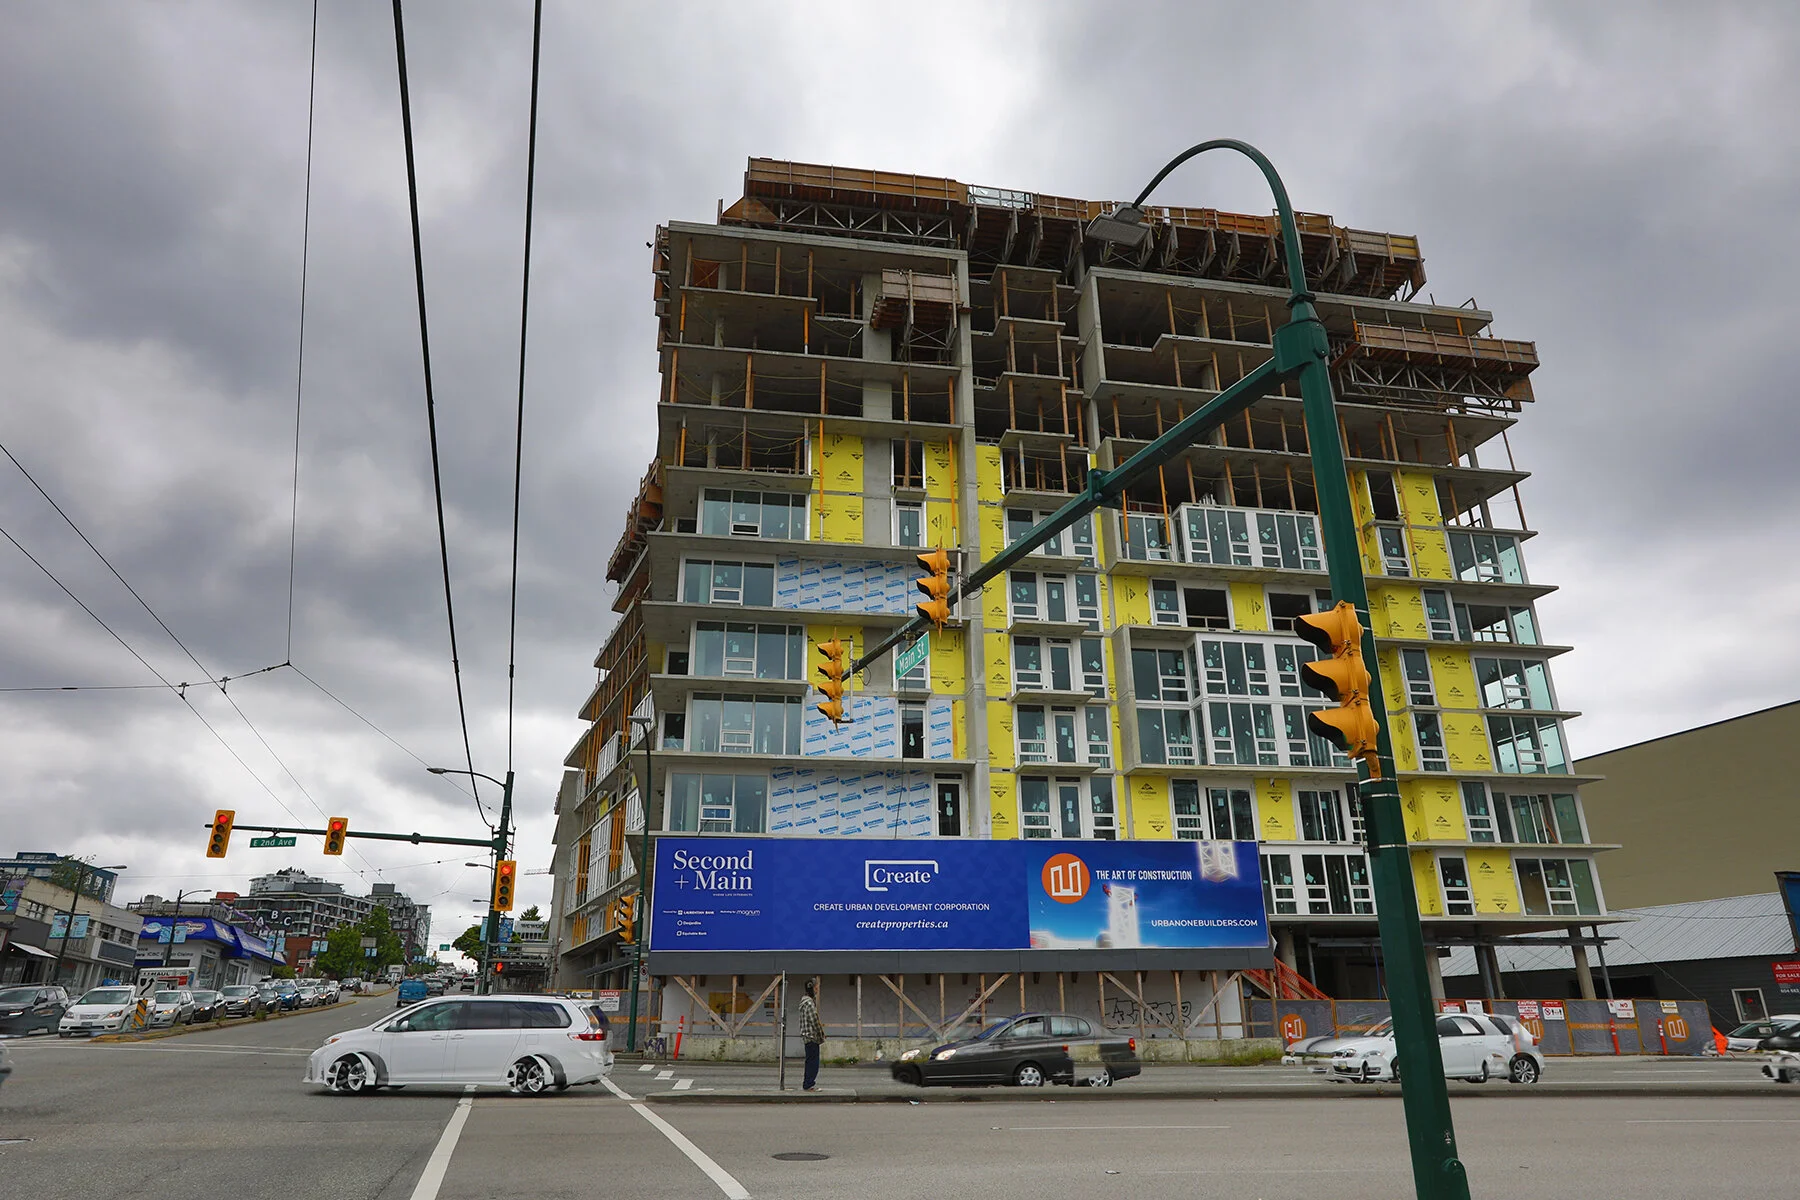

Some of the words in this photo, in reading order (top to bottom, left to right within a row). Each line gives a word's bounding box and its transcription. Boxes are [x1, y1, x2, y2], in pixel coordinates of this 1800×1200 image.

[899, 651, 915, 674] Main
[917, 641, 925, 659] St
[253, 839, 258, 847] E
[260, 839, 276, 847] 2nd
[673, 850, 753, 870] Second
[694, 870, 753, 890] Main
[873, 867, 931, 884] Create
[1096, 870, 1110, 880] THE
[1111, 870, 1126, 880] ART
[1127, 870, 1137, 880] OF
[1138, 870, 1193, 880] CONSTRUCTION
[813, 903, 844, 911] CREATE
[845, 903, 873, 911] URBAN
[874, 903, 933, 911] DEVELOPMENT
[934, 903, 990, 911] CORPORATION
[271, 910, 279, 920] B
[257, 916, 265, 926] A
[283, 916, 292, 926] C
[856, 919, 949, 931] createproperties.ca
[1151, 919, 1258, 928] URBANONEBUILDERS.COM
